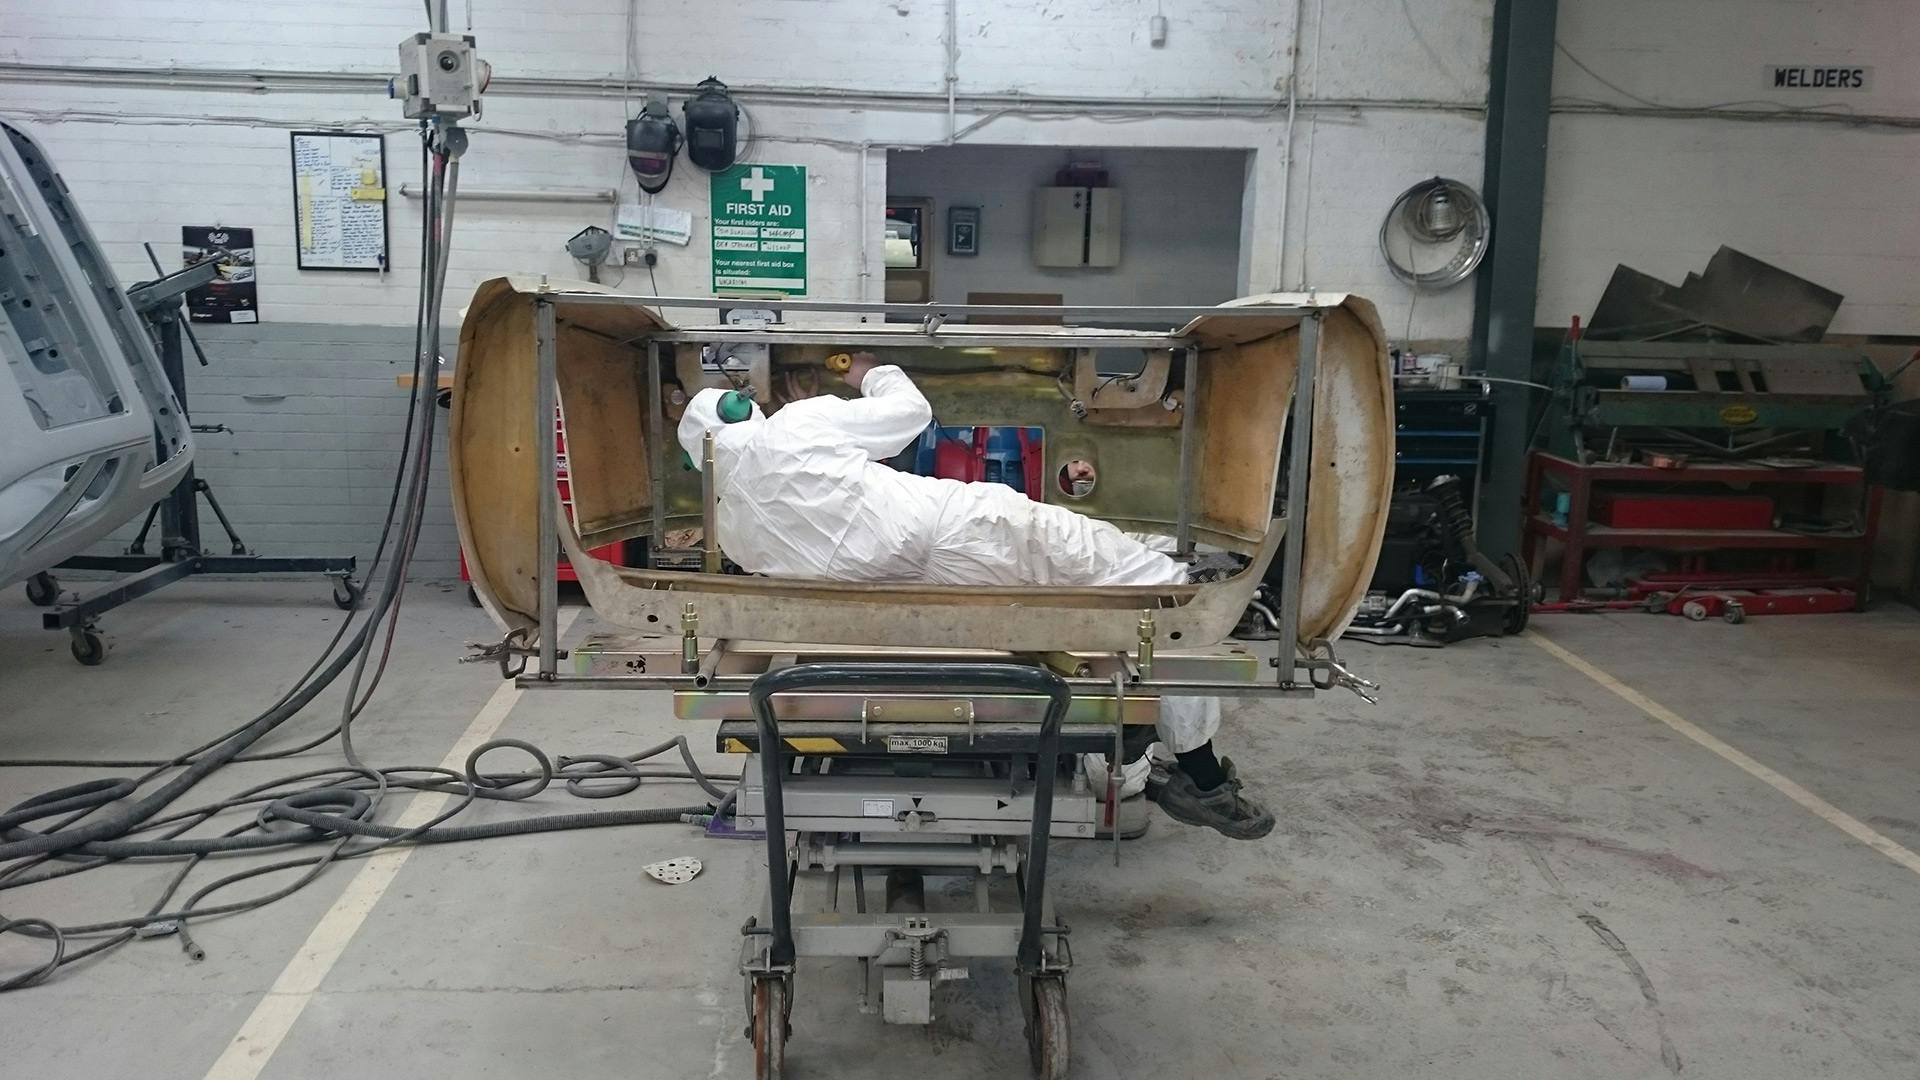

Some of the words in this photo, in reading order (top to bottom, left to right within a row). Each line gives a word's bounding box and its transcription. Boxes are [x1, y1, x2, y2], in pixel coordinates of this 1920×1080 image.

[1774, 68, 1863, 88] WELDERS
[726, 203, 765, 216] FIRST
[768, 204, 792, 216] AID
[731, 218, 744, 226] first
[715, 259, 730, 267] Your
[771, 260, 782, 268] aid
[913, 739, 932, 747] 1000
[933, 740, 944, 748] kg
